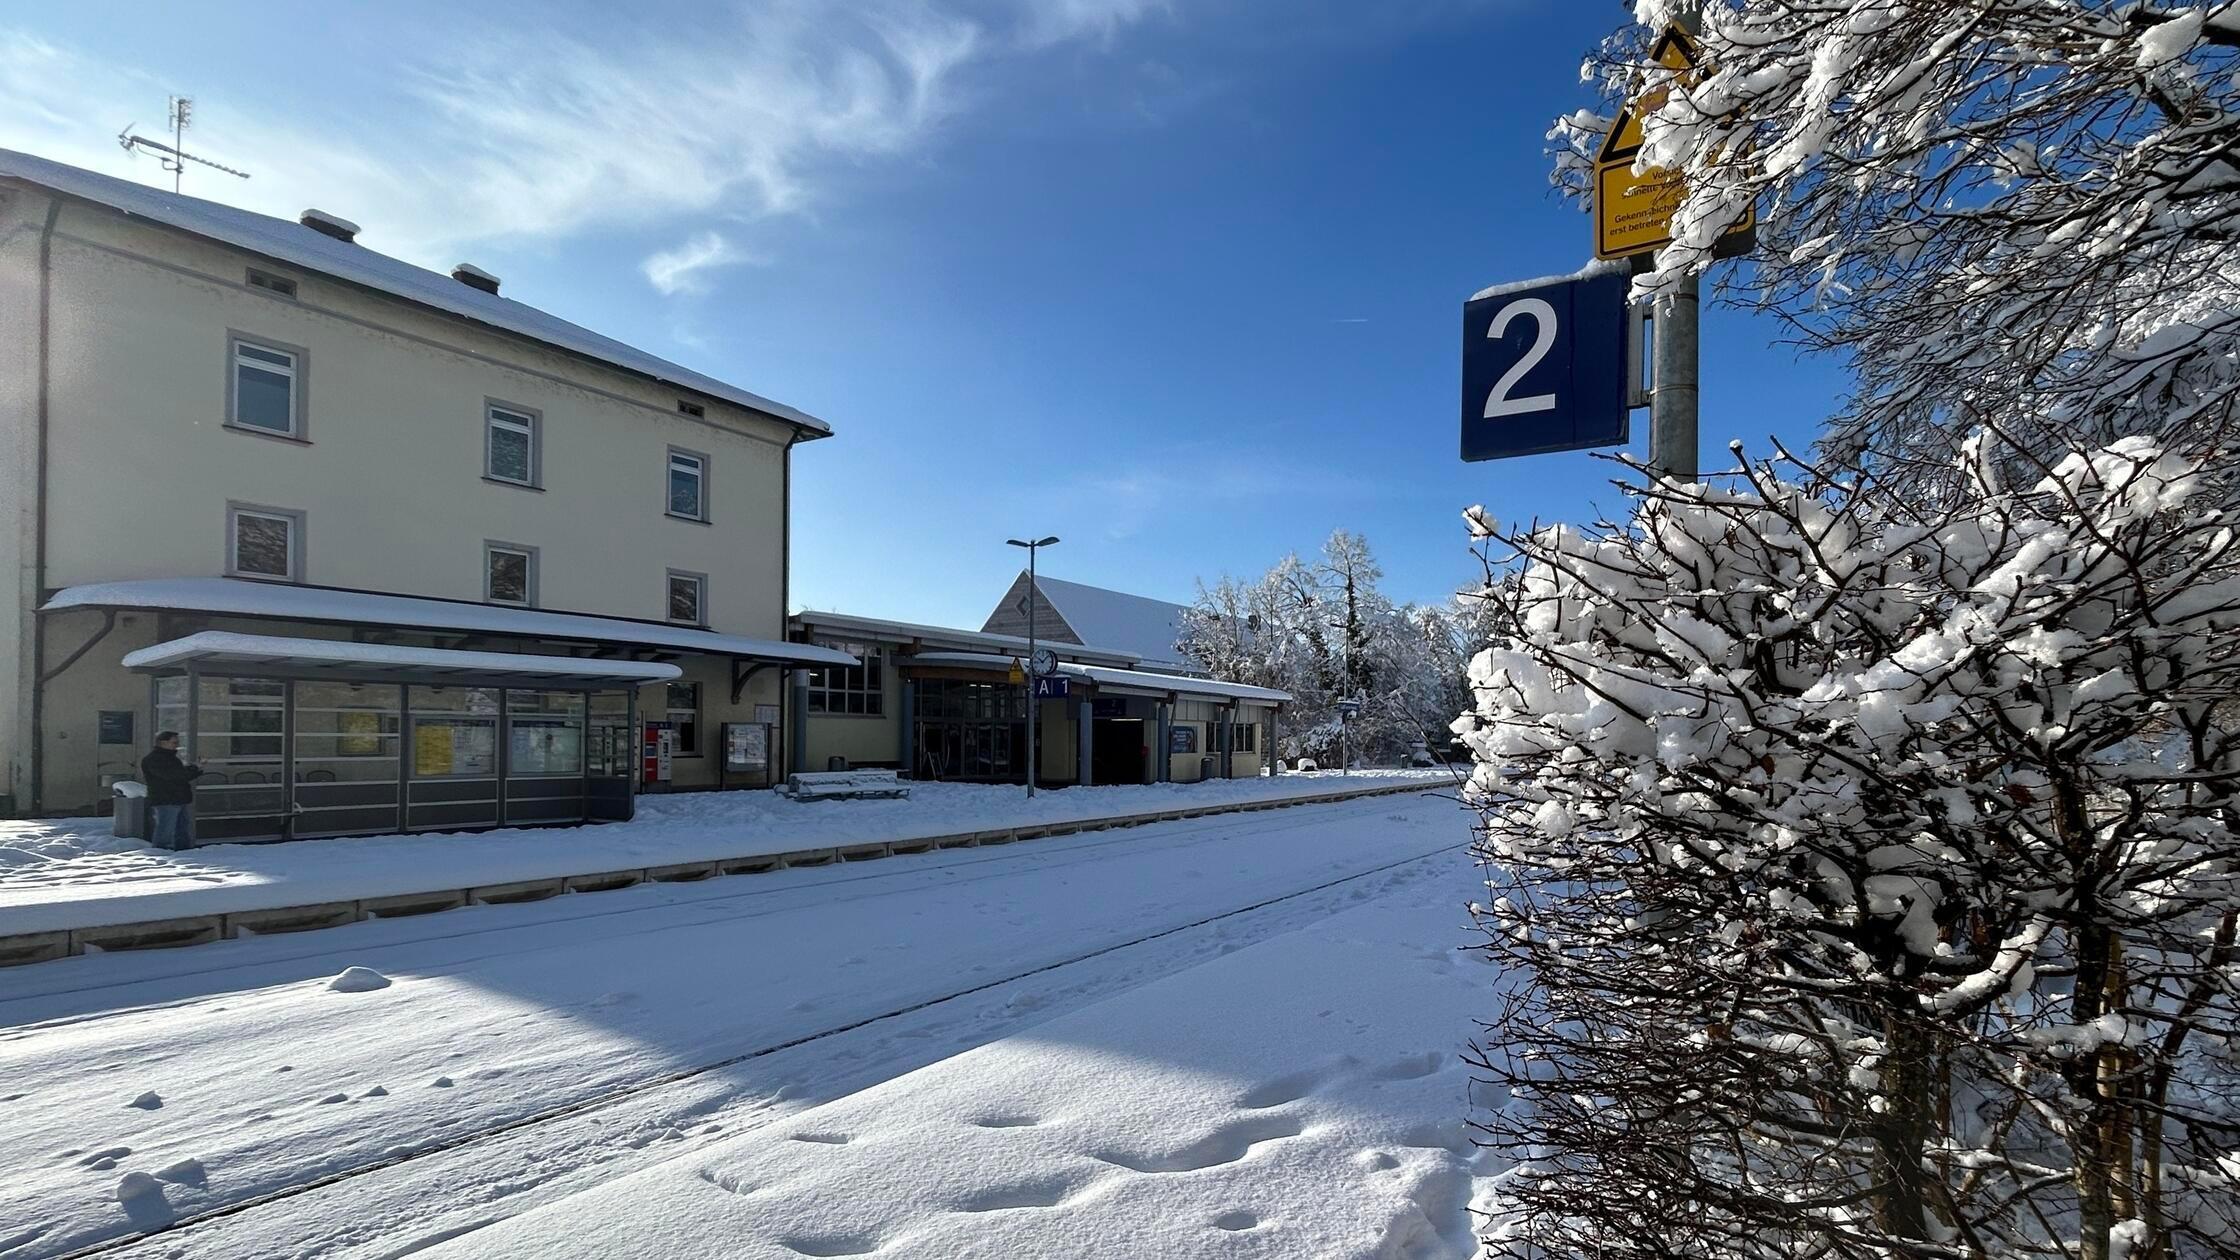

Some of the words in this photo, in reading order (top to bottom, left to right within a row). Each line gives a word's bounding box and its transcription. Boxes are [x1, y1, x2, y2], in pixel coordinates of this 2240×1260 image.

[1609, 225, 1627, 236] erst
[1484, 298, 1557, 418] 2
[1039, 679, 1049, 695] A
[1061, 679, 1068, 694] 1
